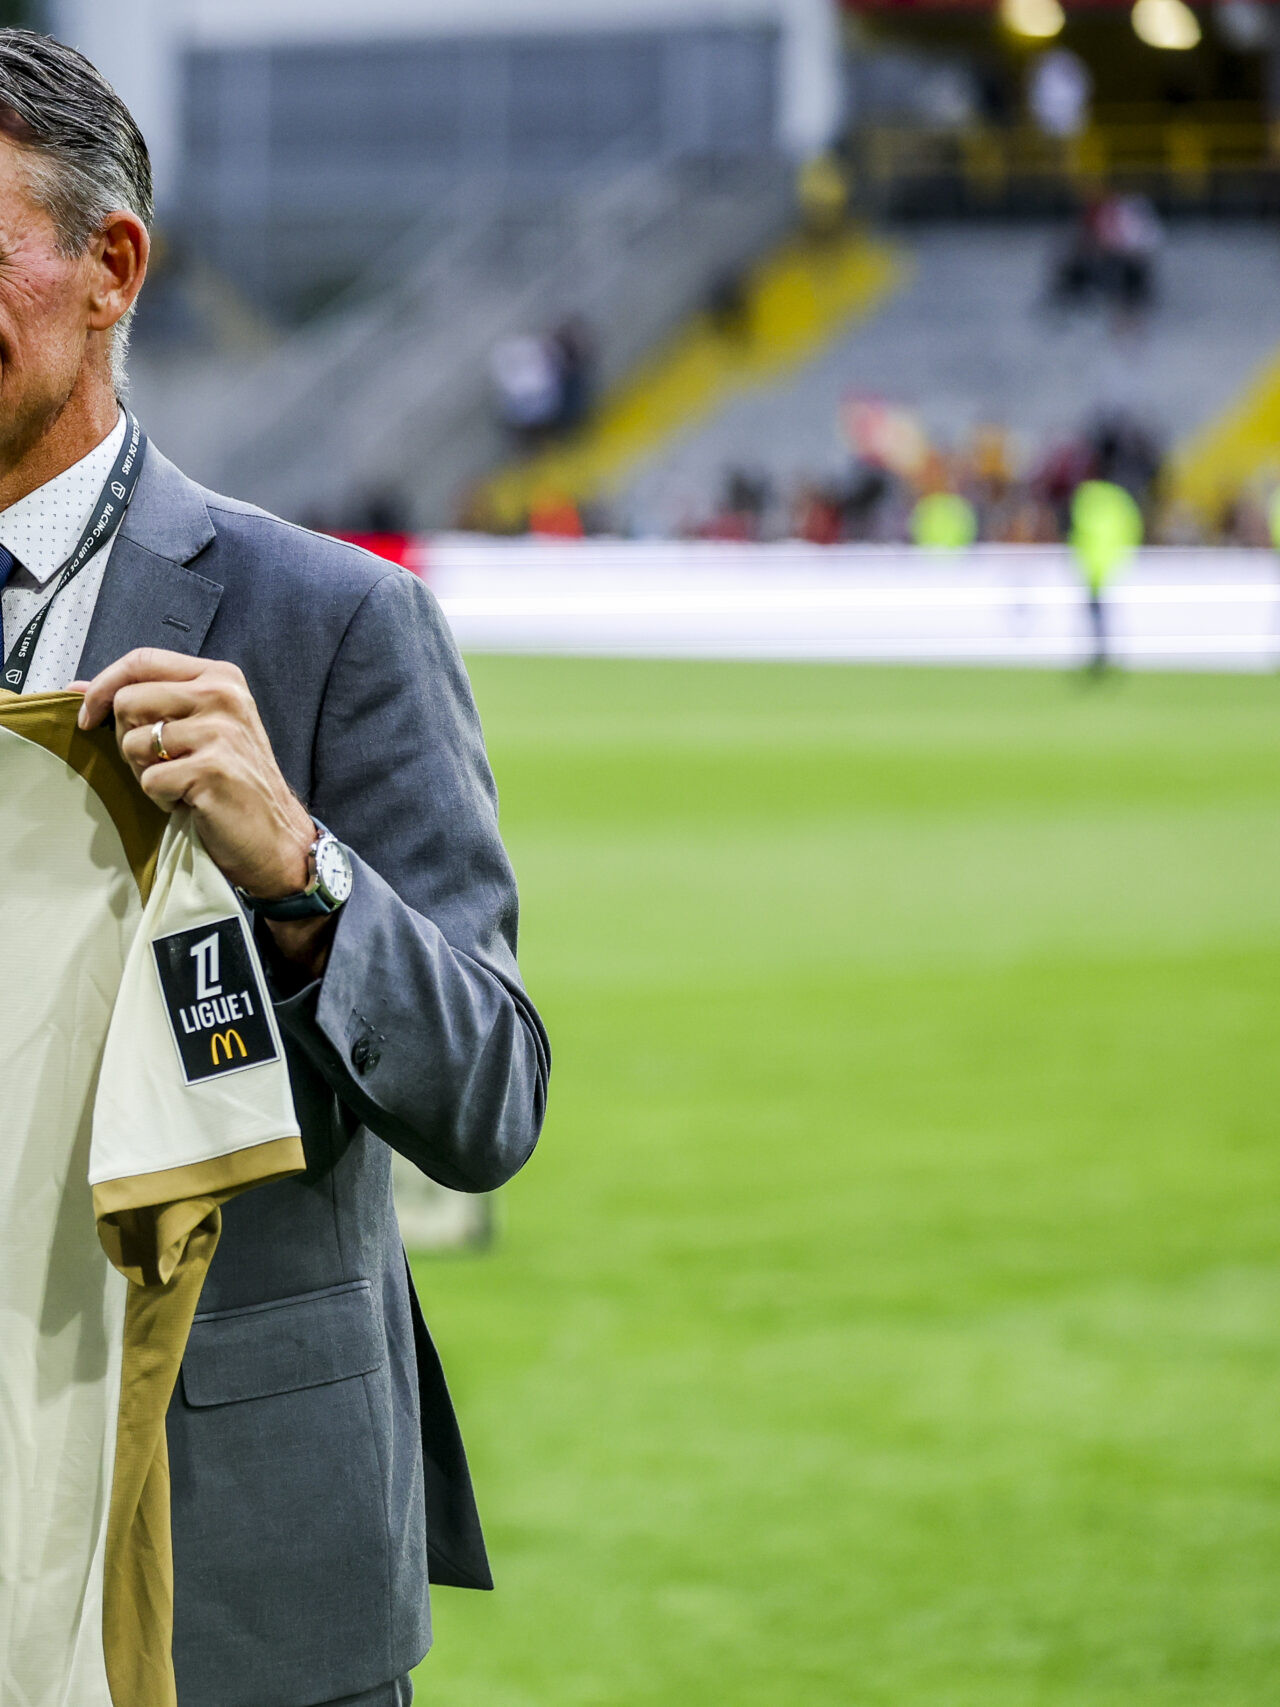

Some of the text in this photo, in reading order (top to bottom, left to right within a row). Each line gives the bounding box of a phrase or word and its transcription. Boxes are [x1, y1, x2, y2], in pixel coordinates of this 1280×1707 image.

[121, 454, 134, 475] LENS
[92, 502, 114, 538] RACING
[78, 536, 95, 559] CLUB
[18, 637, 31, 658] LENS
